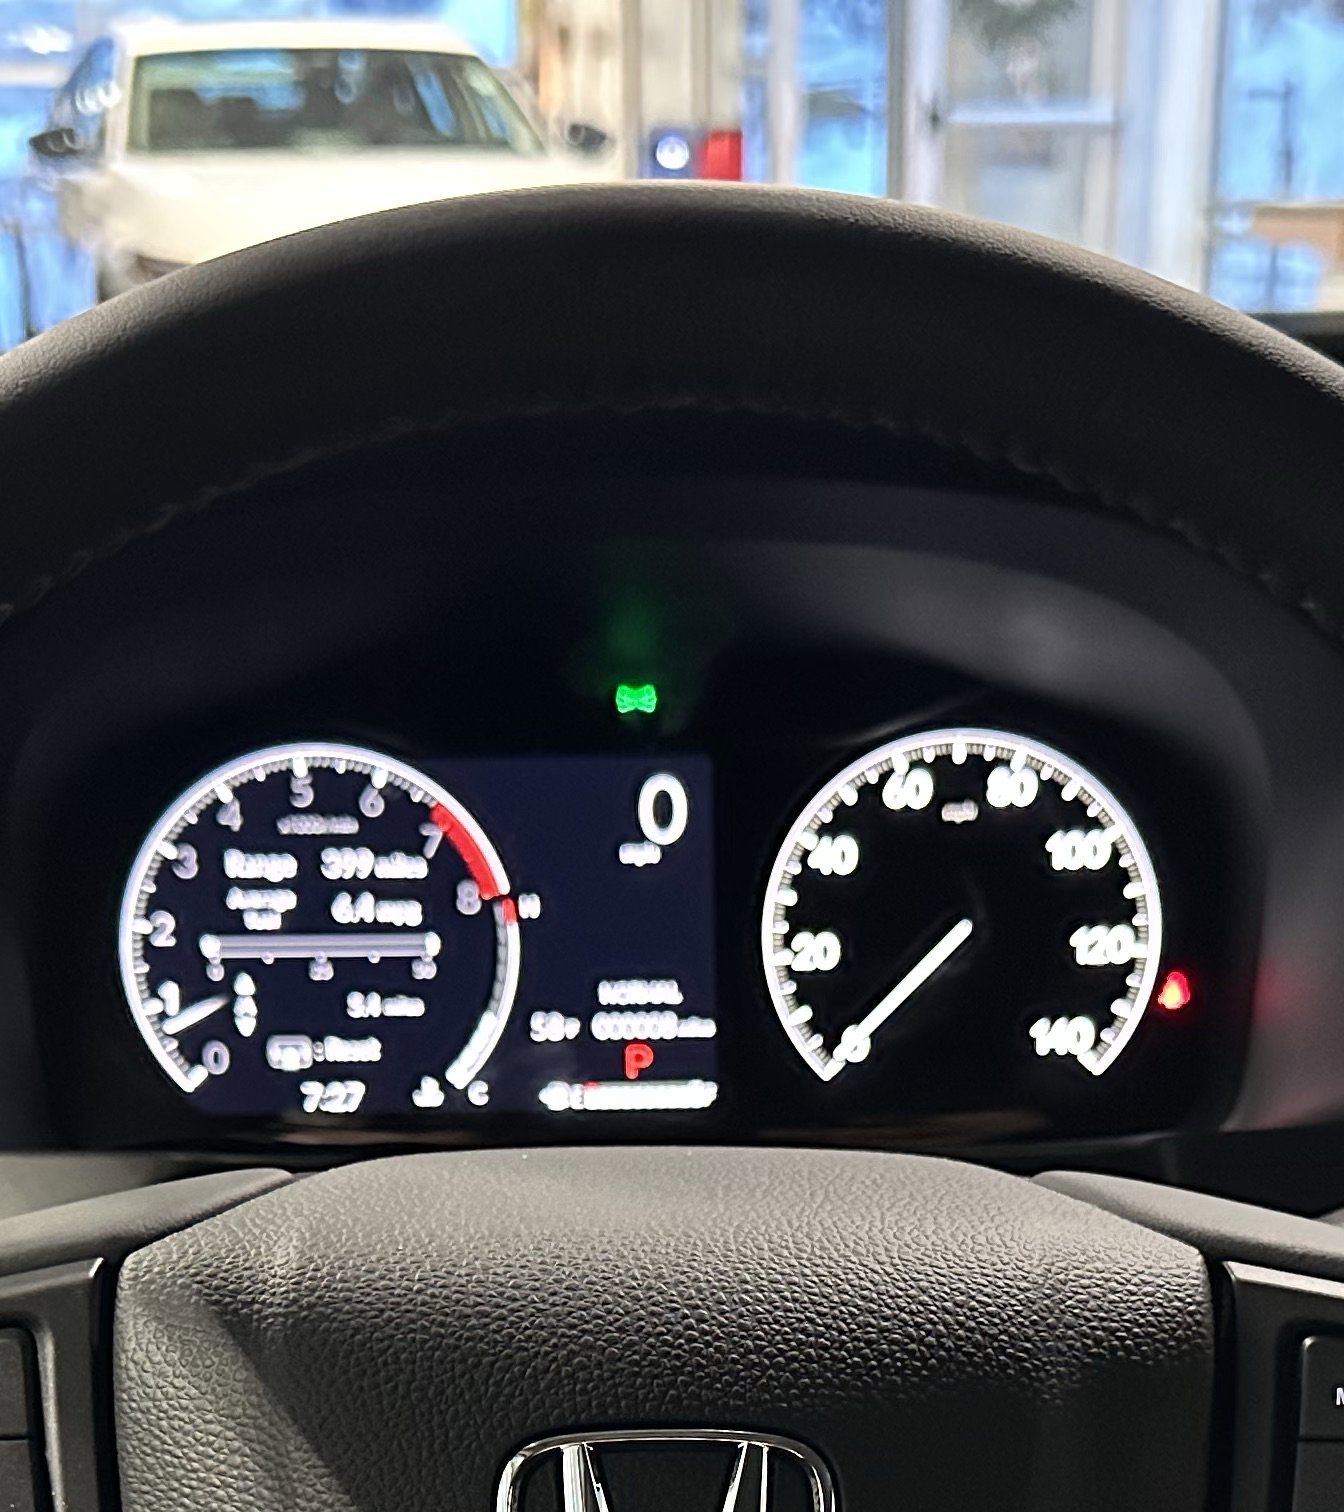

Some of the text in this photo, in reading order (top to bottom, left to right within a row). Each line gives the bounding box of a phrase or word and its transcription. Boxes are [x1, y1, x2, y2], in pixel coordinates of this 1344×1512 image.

[290, 776, 314, 808] 5
[358, 782, 385, 818] 6
[882, 767, 934, 810] 60
[986, 767, 1039, 807] 80
[216, 799, 243, 832] 4
[638, 773, 687, 845] 0
[419, 821, 445, 860] 7
[807, 834, 859, 875] 40
[1045, 829, 1112, 870] 100
[172, 842, 198, 879] 3
[456, 880, 482, 915] 8
[150, 910, 177, 948] 2
[1070, 924, 1135, 966] 120
[790, 932, 841, 971] 20
[158, 981, 180, 1016] 1
[1029, 1016, 1096, 1057] 140
[202, 1040, 230, 1076] 0
[624, 1043, 654, 1079] P
